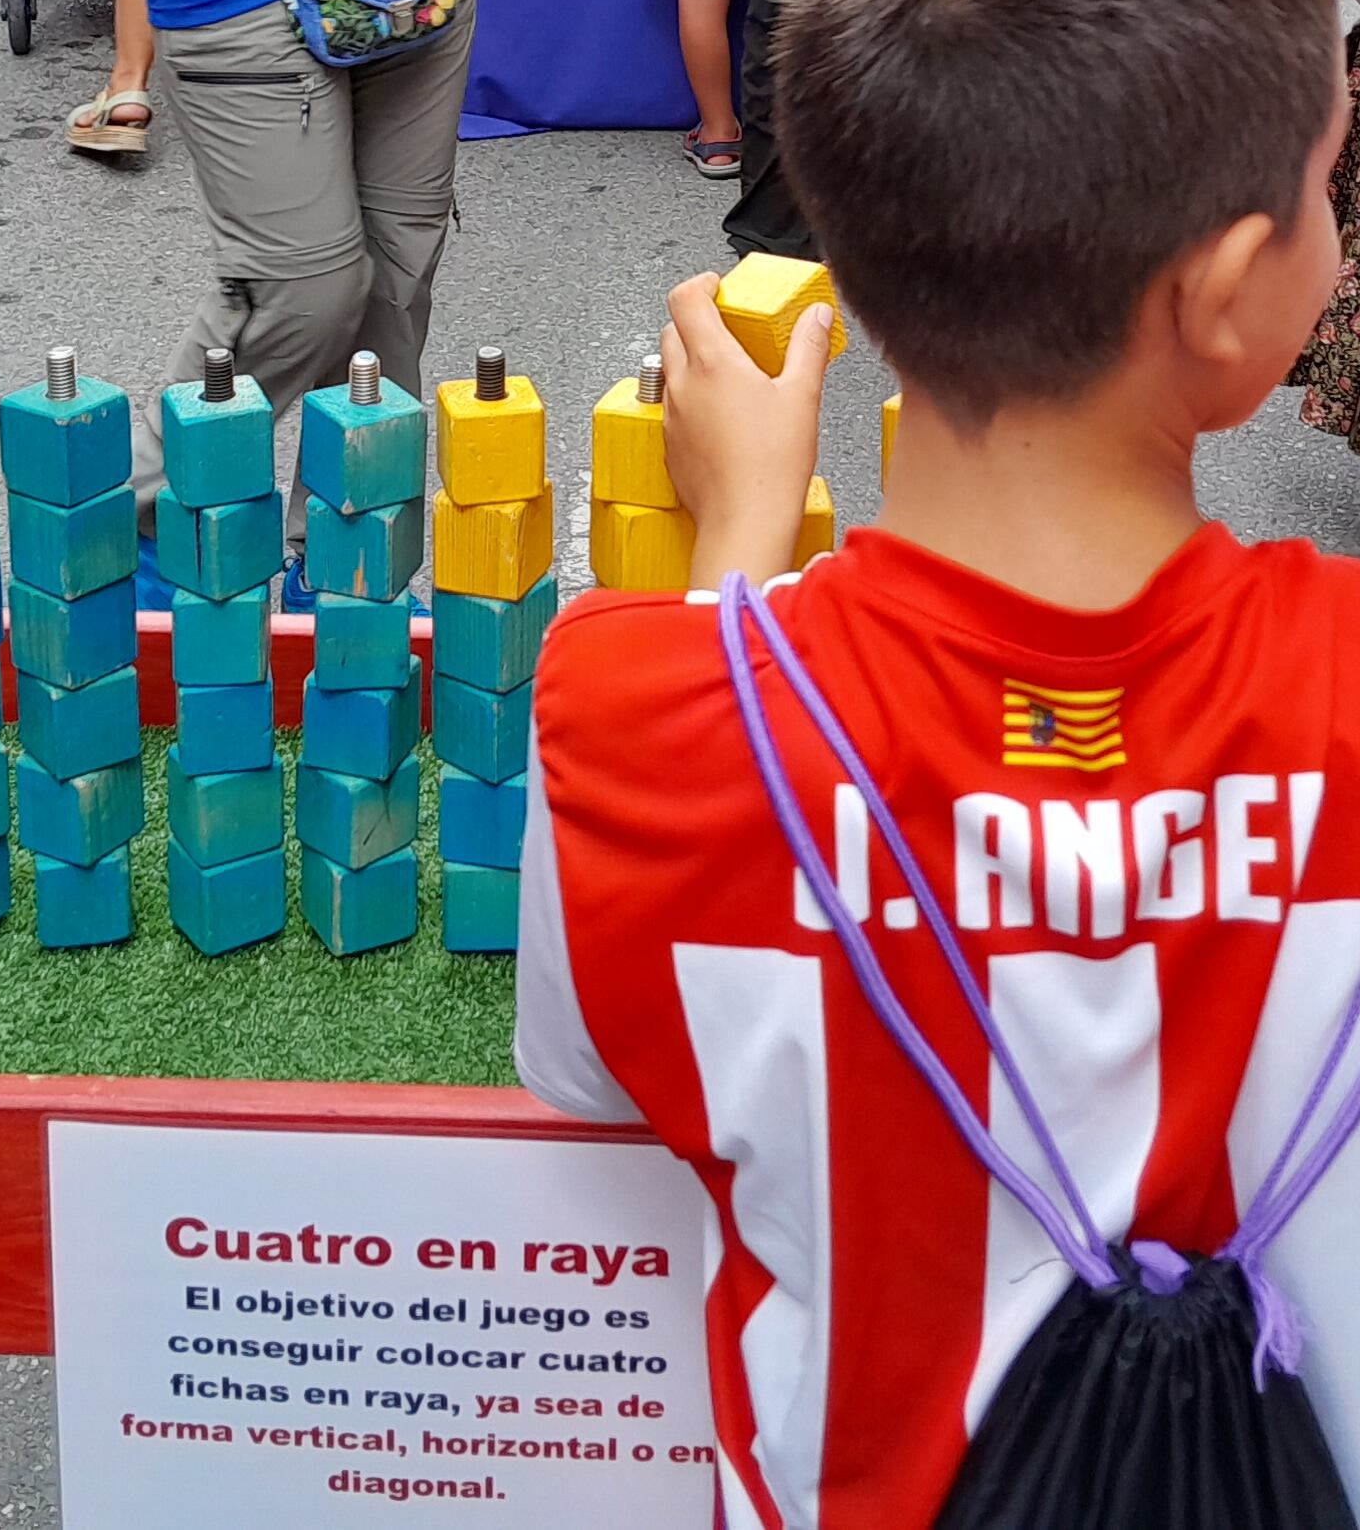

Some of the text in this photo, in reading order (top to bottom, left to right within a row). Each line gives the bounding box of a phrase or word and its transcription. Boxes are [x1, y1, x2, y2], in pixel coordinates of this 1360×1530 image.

[164, 1216, 671, 1286] Cuatro en raya
[185, 1286, 650, 1333] El objetivo del juego es
[167, 1333, 668, 1375] conseguir colocar cuatro
[169, 1373, 665, 1419] fichas en raya, ya sea de
[120, 1413, 715, 1464] forma vertical, horizontal o en
[327, 1469, 507, 1502] diagonal.
